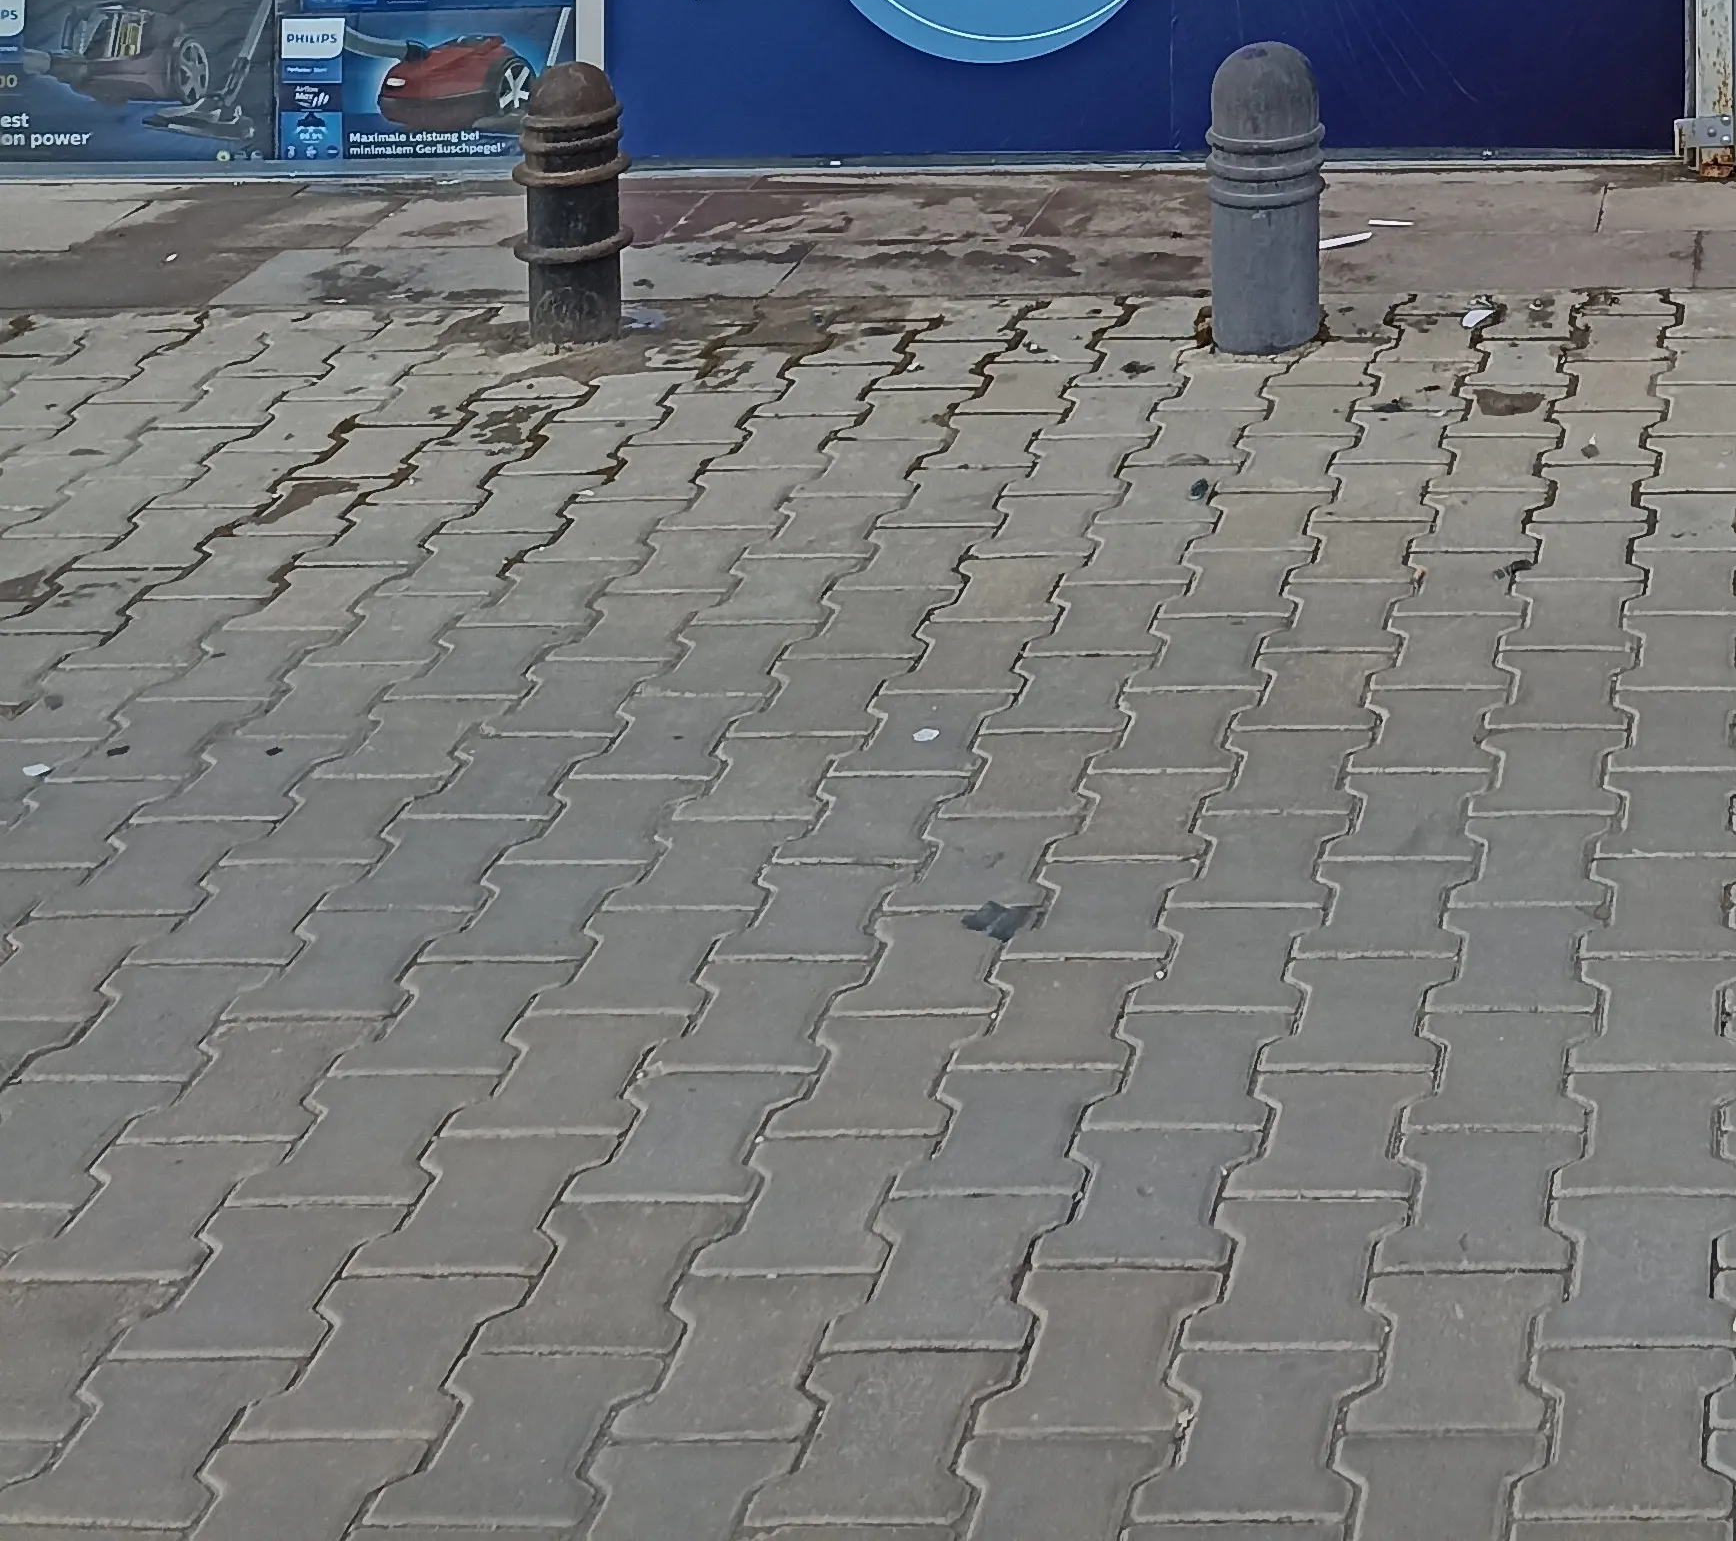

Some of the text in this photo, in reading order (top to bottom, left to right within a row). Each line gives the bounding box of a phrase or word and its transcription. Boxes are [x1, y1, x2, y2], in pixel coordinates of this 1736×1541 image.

[287, 33, 337, 43] PHILIPS
[350, 130, 479, 142] Maximale Leistung bei
[350, 144, 413, 155] minimalem
